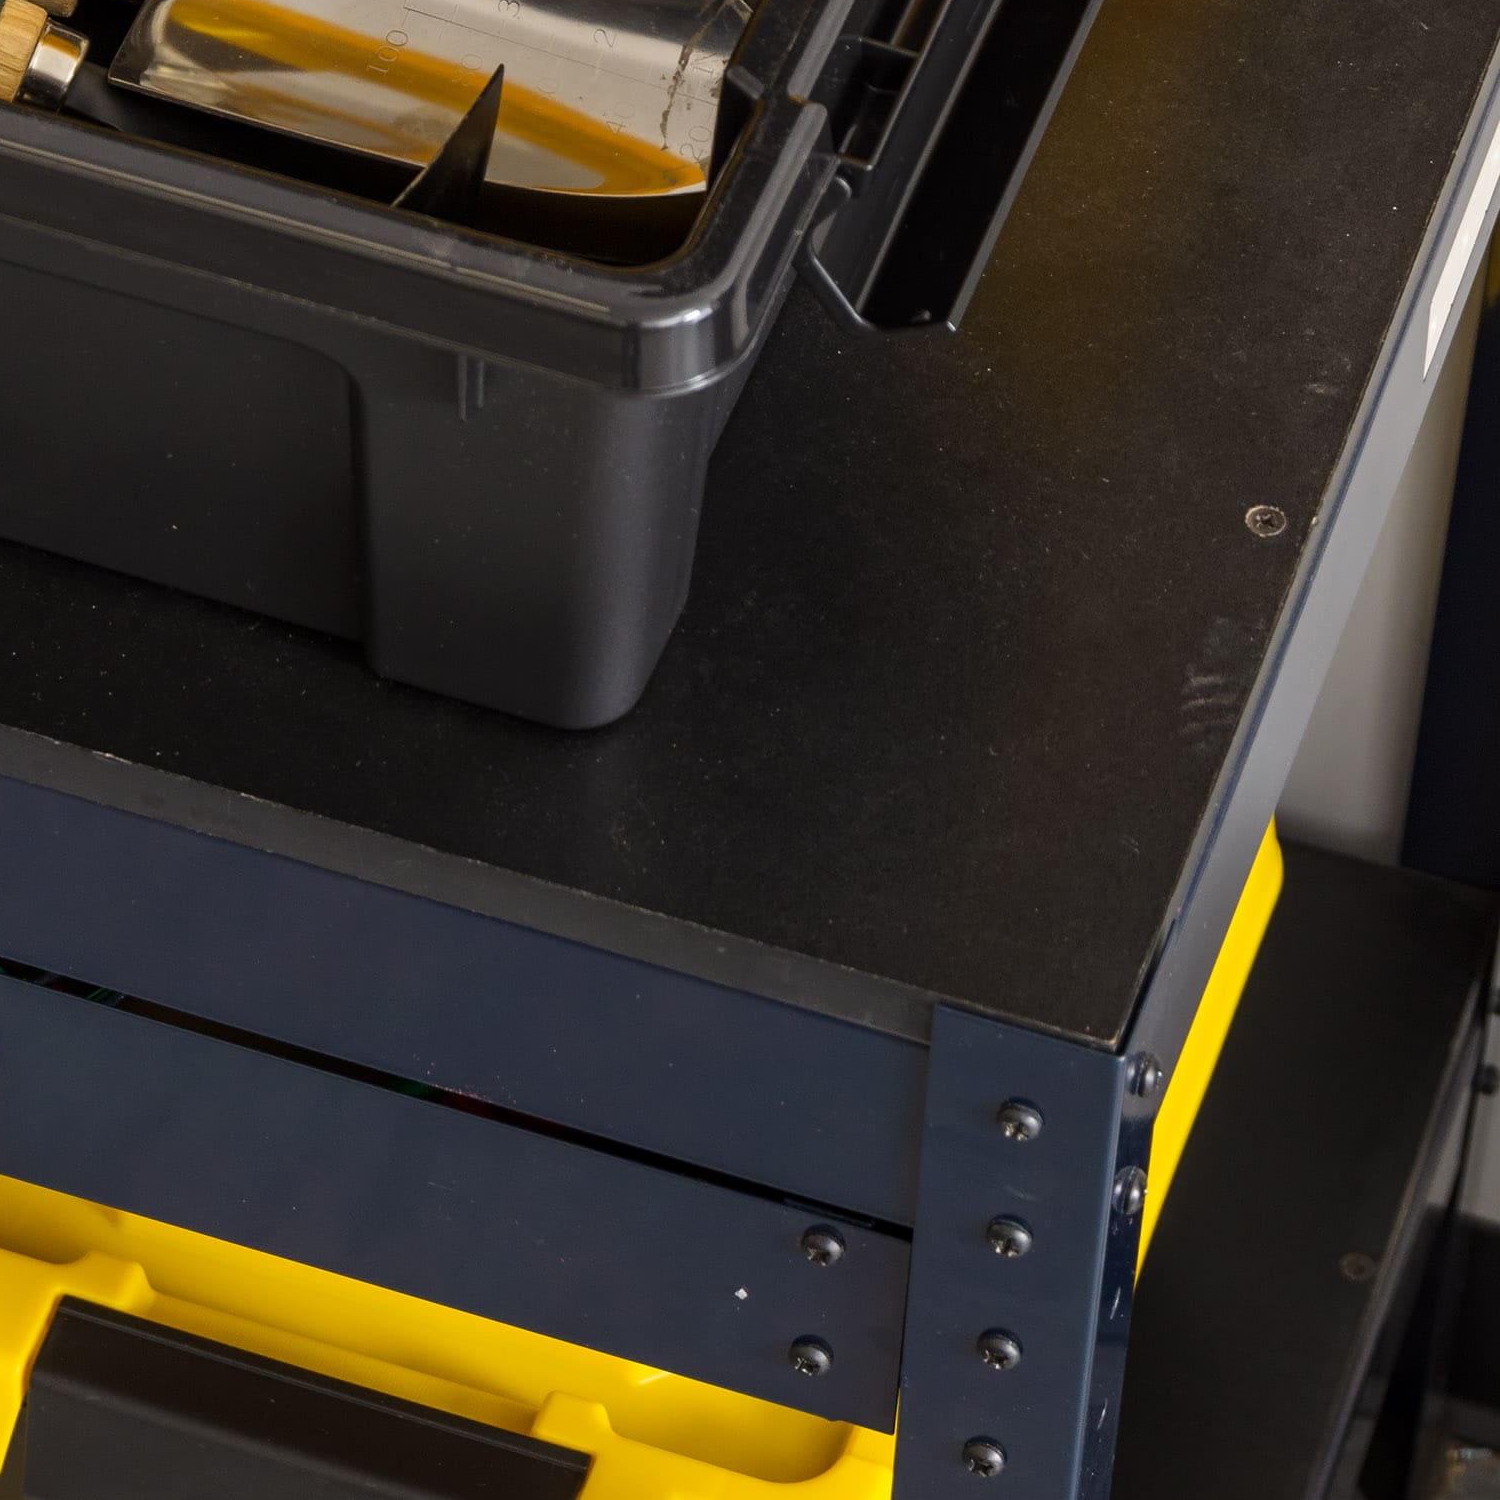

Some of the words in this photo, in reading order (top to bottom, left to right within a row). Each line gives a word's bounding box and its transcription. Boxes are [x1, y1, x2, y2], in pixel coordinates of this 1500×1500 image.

[367, 29, 409, 76] 100
[593, 28, 618, 48] 2
[679, 125, 713, 166] 20
